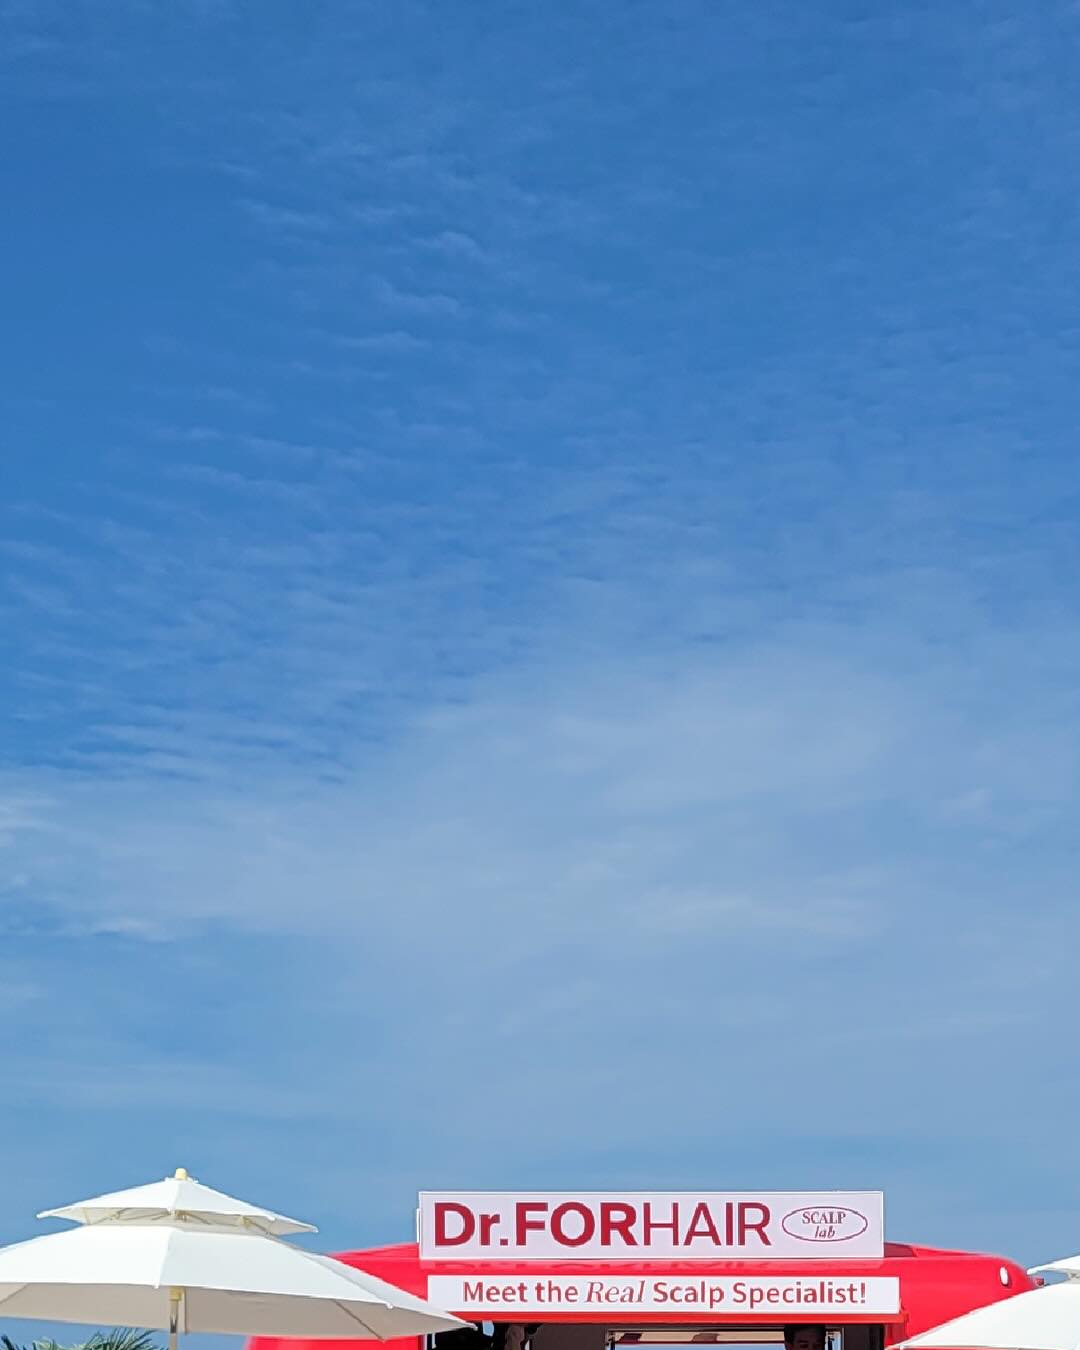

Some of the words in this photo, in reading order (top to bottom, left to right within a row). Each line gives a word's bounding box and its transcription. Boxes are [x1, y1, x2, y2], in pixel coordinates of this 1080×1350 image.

[435, 1202, 772, 1247] Dr.FORHAIR
[802, 1211, 846, 1225] SCALP
[814, 1226, 835, 1239] lab
[463, 1281, 528, 1303] Meet
[535, 1280, 579, 1303] the
[584, 1280, 646, 1303] Real
[653, 1280, 725, 1309] Scalp
[733, 1280, 866, 1309] Specialist!
